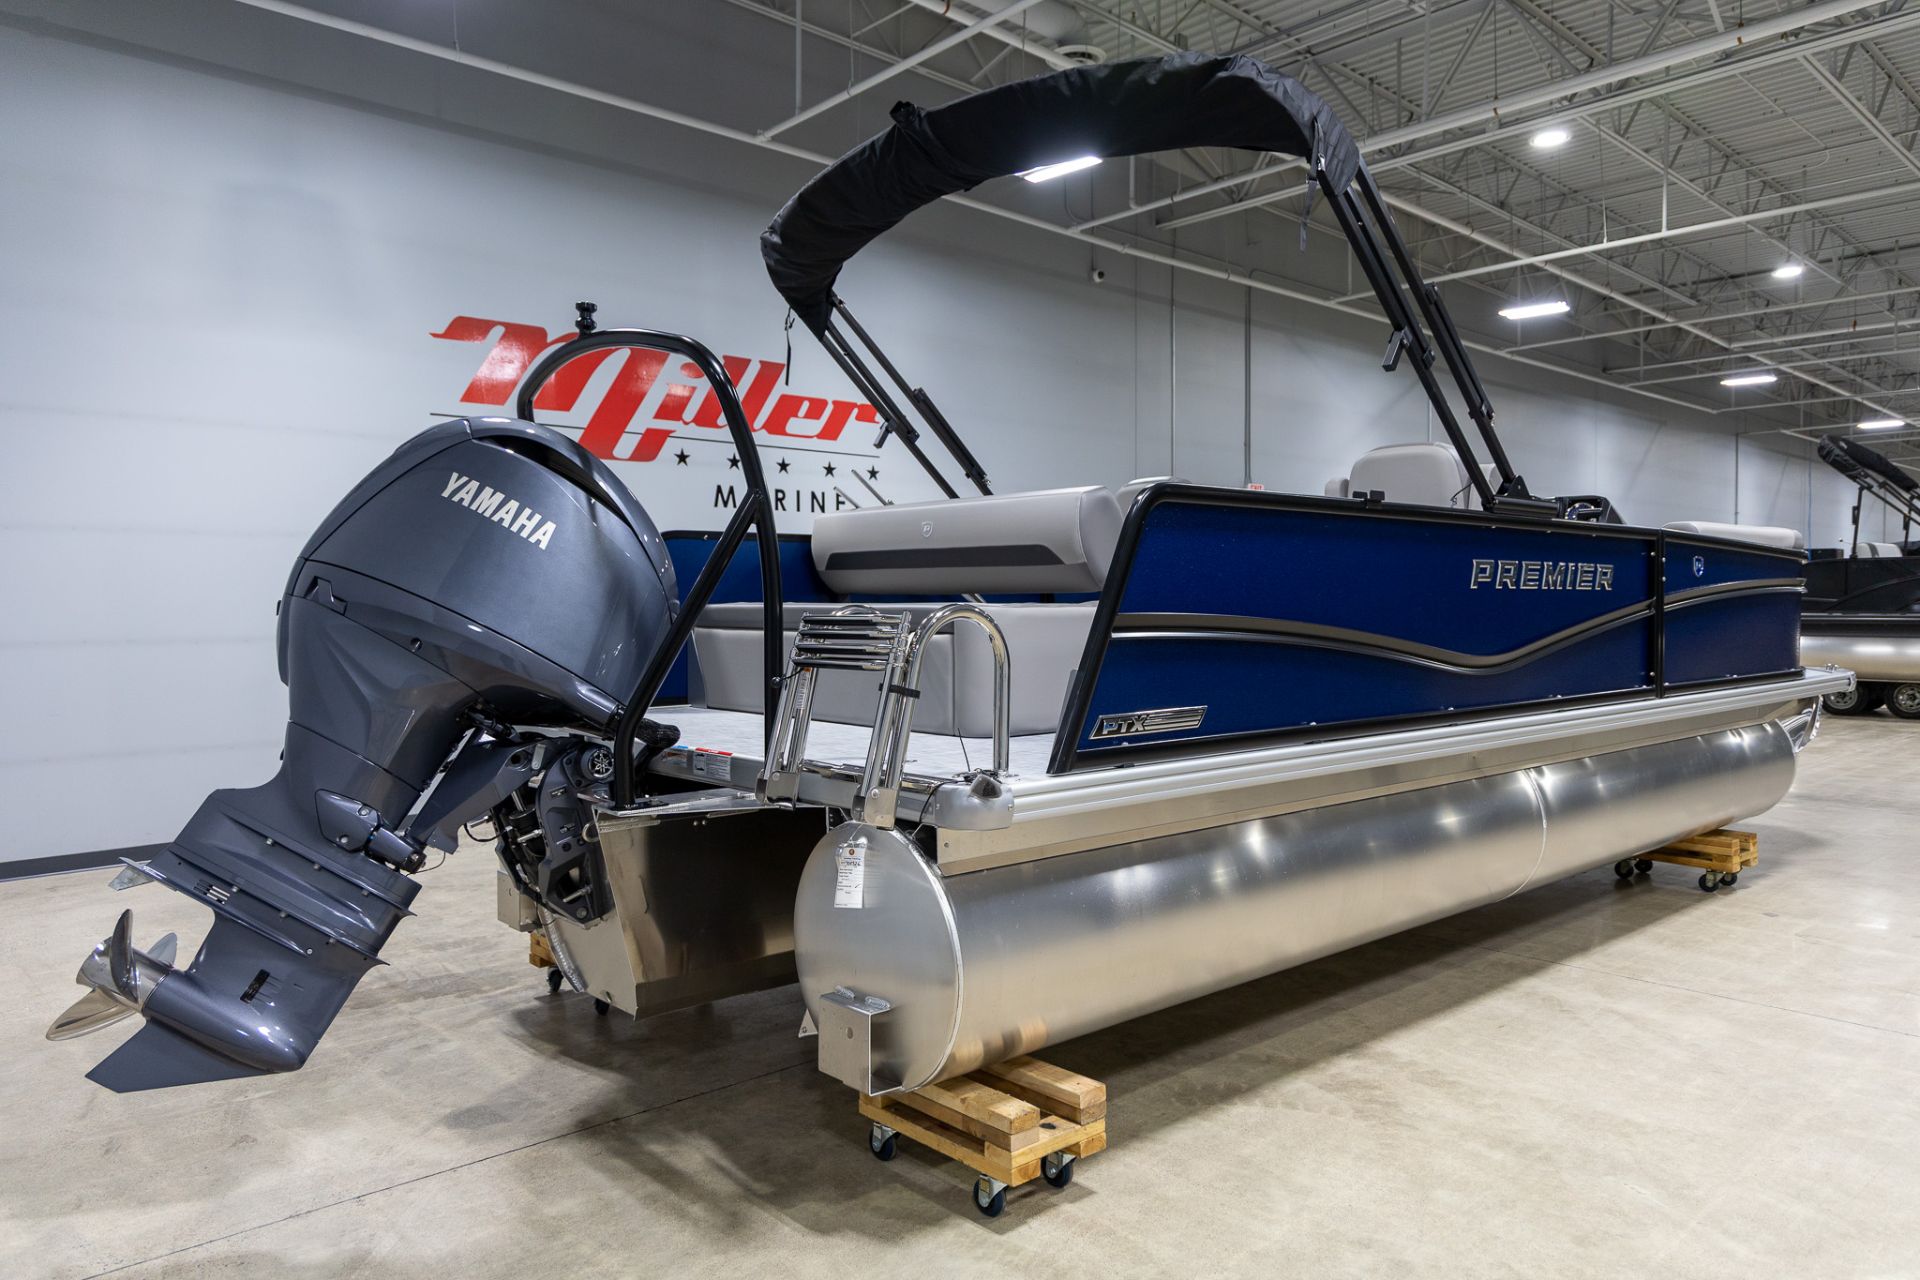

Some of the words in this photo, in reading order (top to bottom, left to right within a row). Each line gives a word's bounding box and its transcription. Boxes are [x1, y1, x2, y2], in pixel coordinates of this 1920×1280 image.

[429, 316, 881, 462] Miller
[441, 472, 557, 551] YAMAHA
[714, 484, 846, 514] MRINE
[1470, 559, 1614, 591] PREMIER
[1102, 714, 1150, 735] PTX
